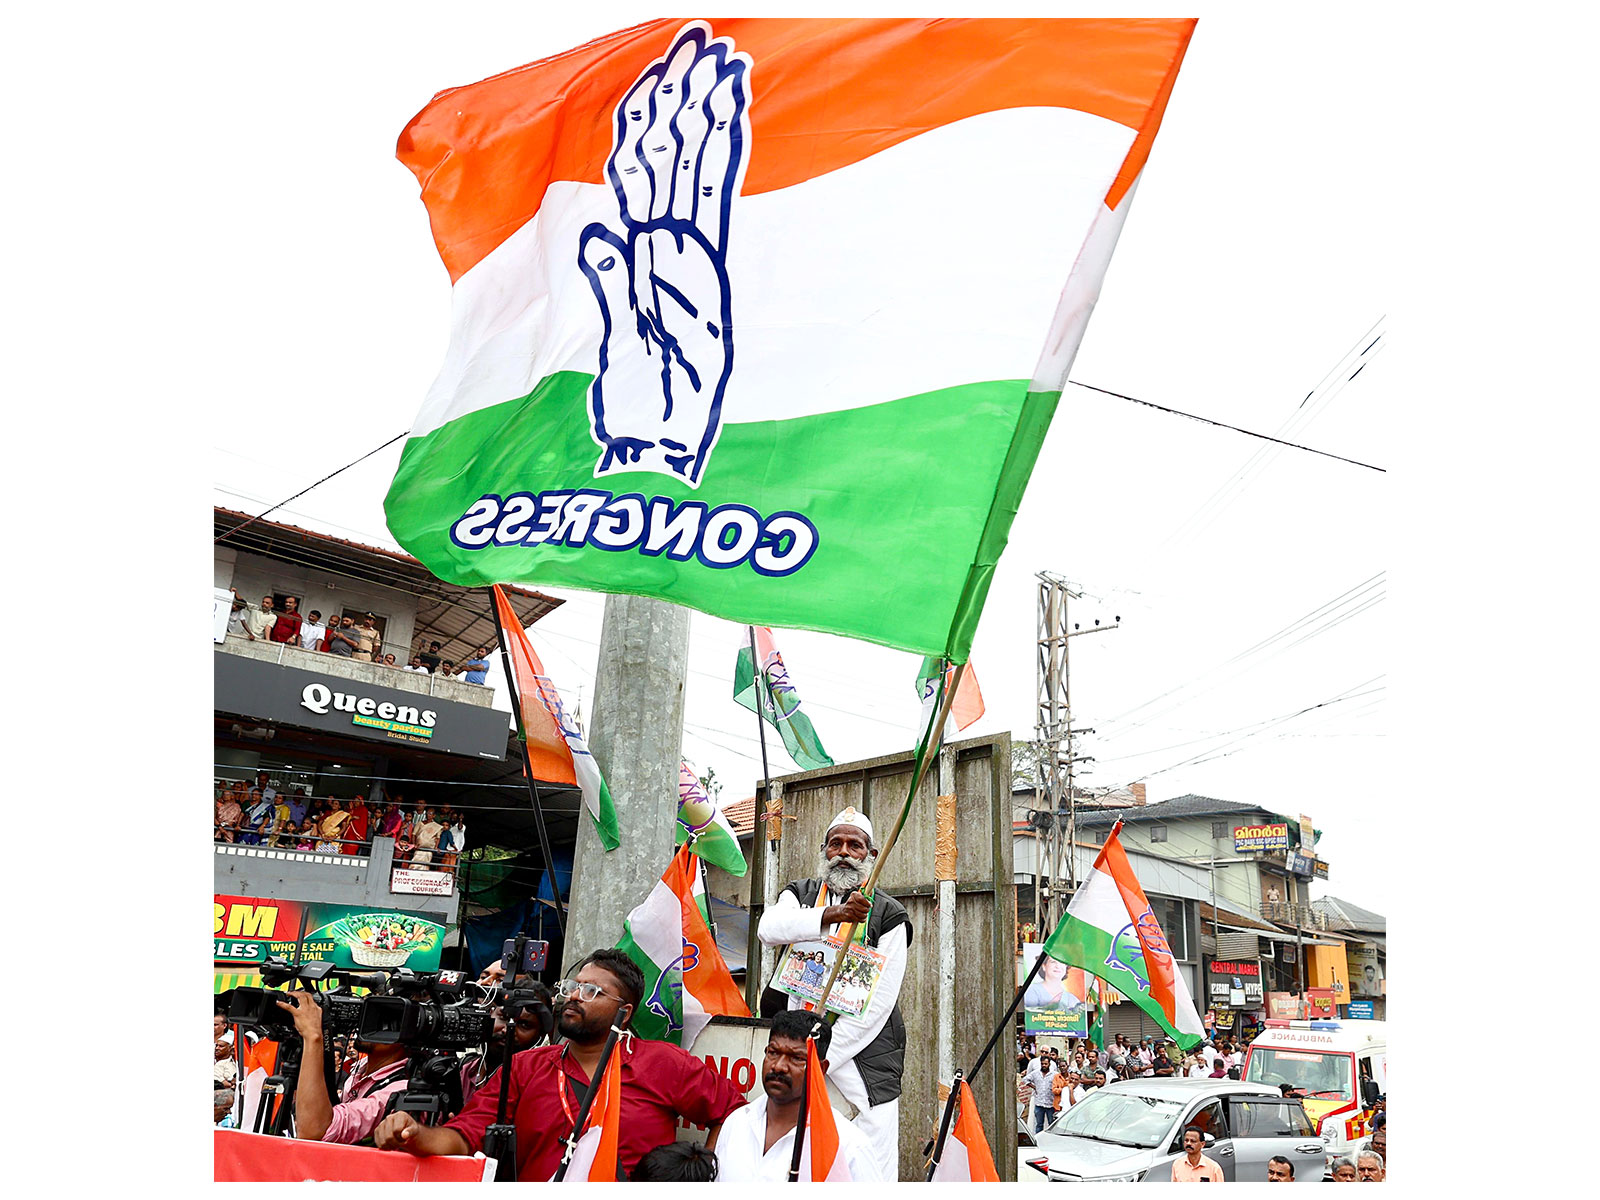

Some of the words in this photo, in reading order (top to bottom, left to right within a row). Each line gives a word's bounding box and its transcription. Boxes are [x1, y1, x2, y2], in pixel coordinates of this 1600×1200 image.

[300, 683, 437, 728] Queens
[354, 714, 391, 730] beauty
[392, 724, 433, 738] parlour
[387, 731, 407, 740] Bridal
[409, 735, 430, 744] Studio
[394, 877, 443, 887] PROFESSIONAL
[214, 942, 259, 958] LES
[270, 942, 308, 952] WHOE
[309, 942, 335, 952] SALE
[1210, 961, 1238, 975] CENTRAL
[705, 1055, 756, 1093] NO
